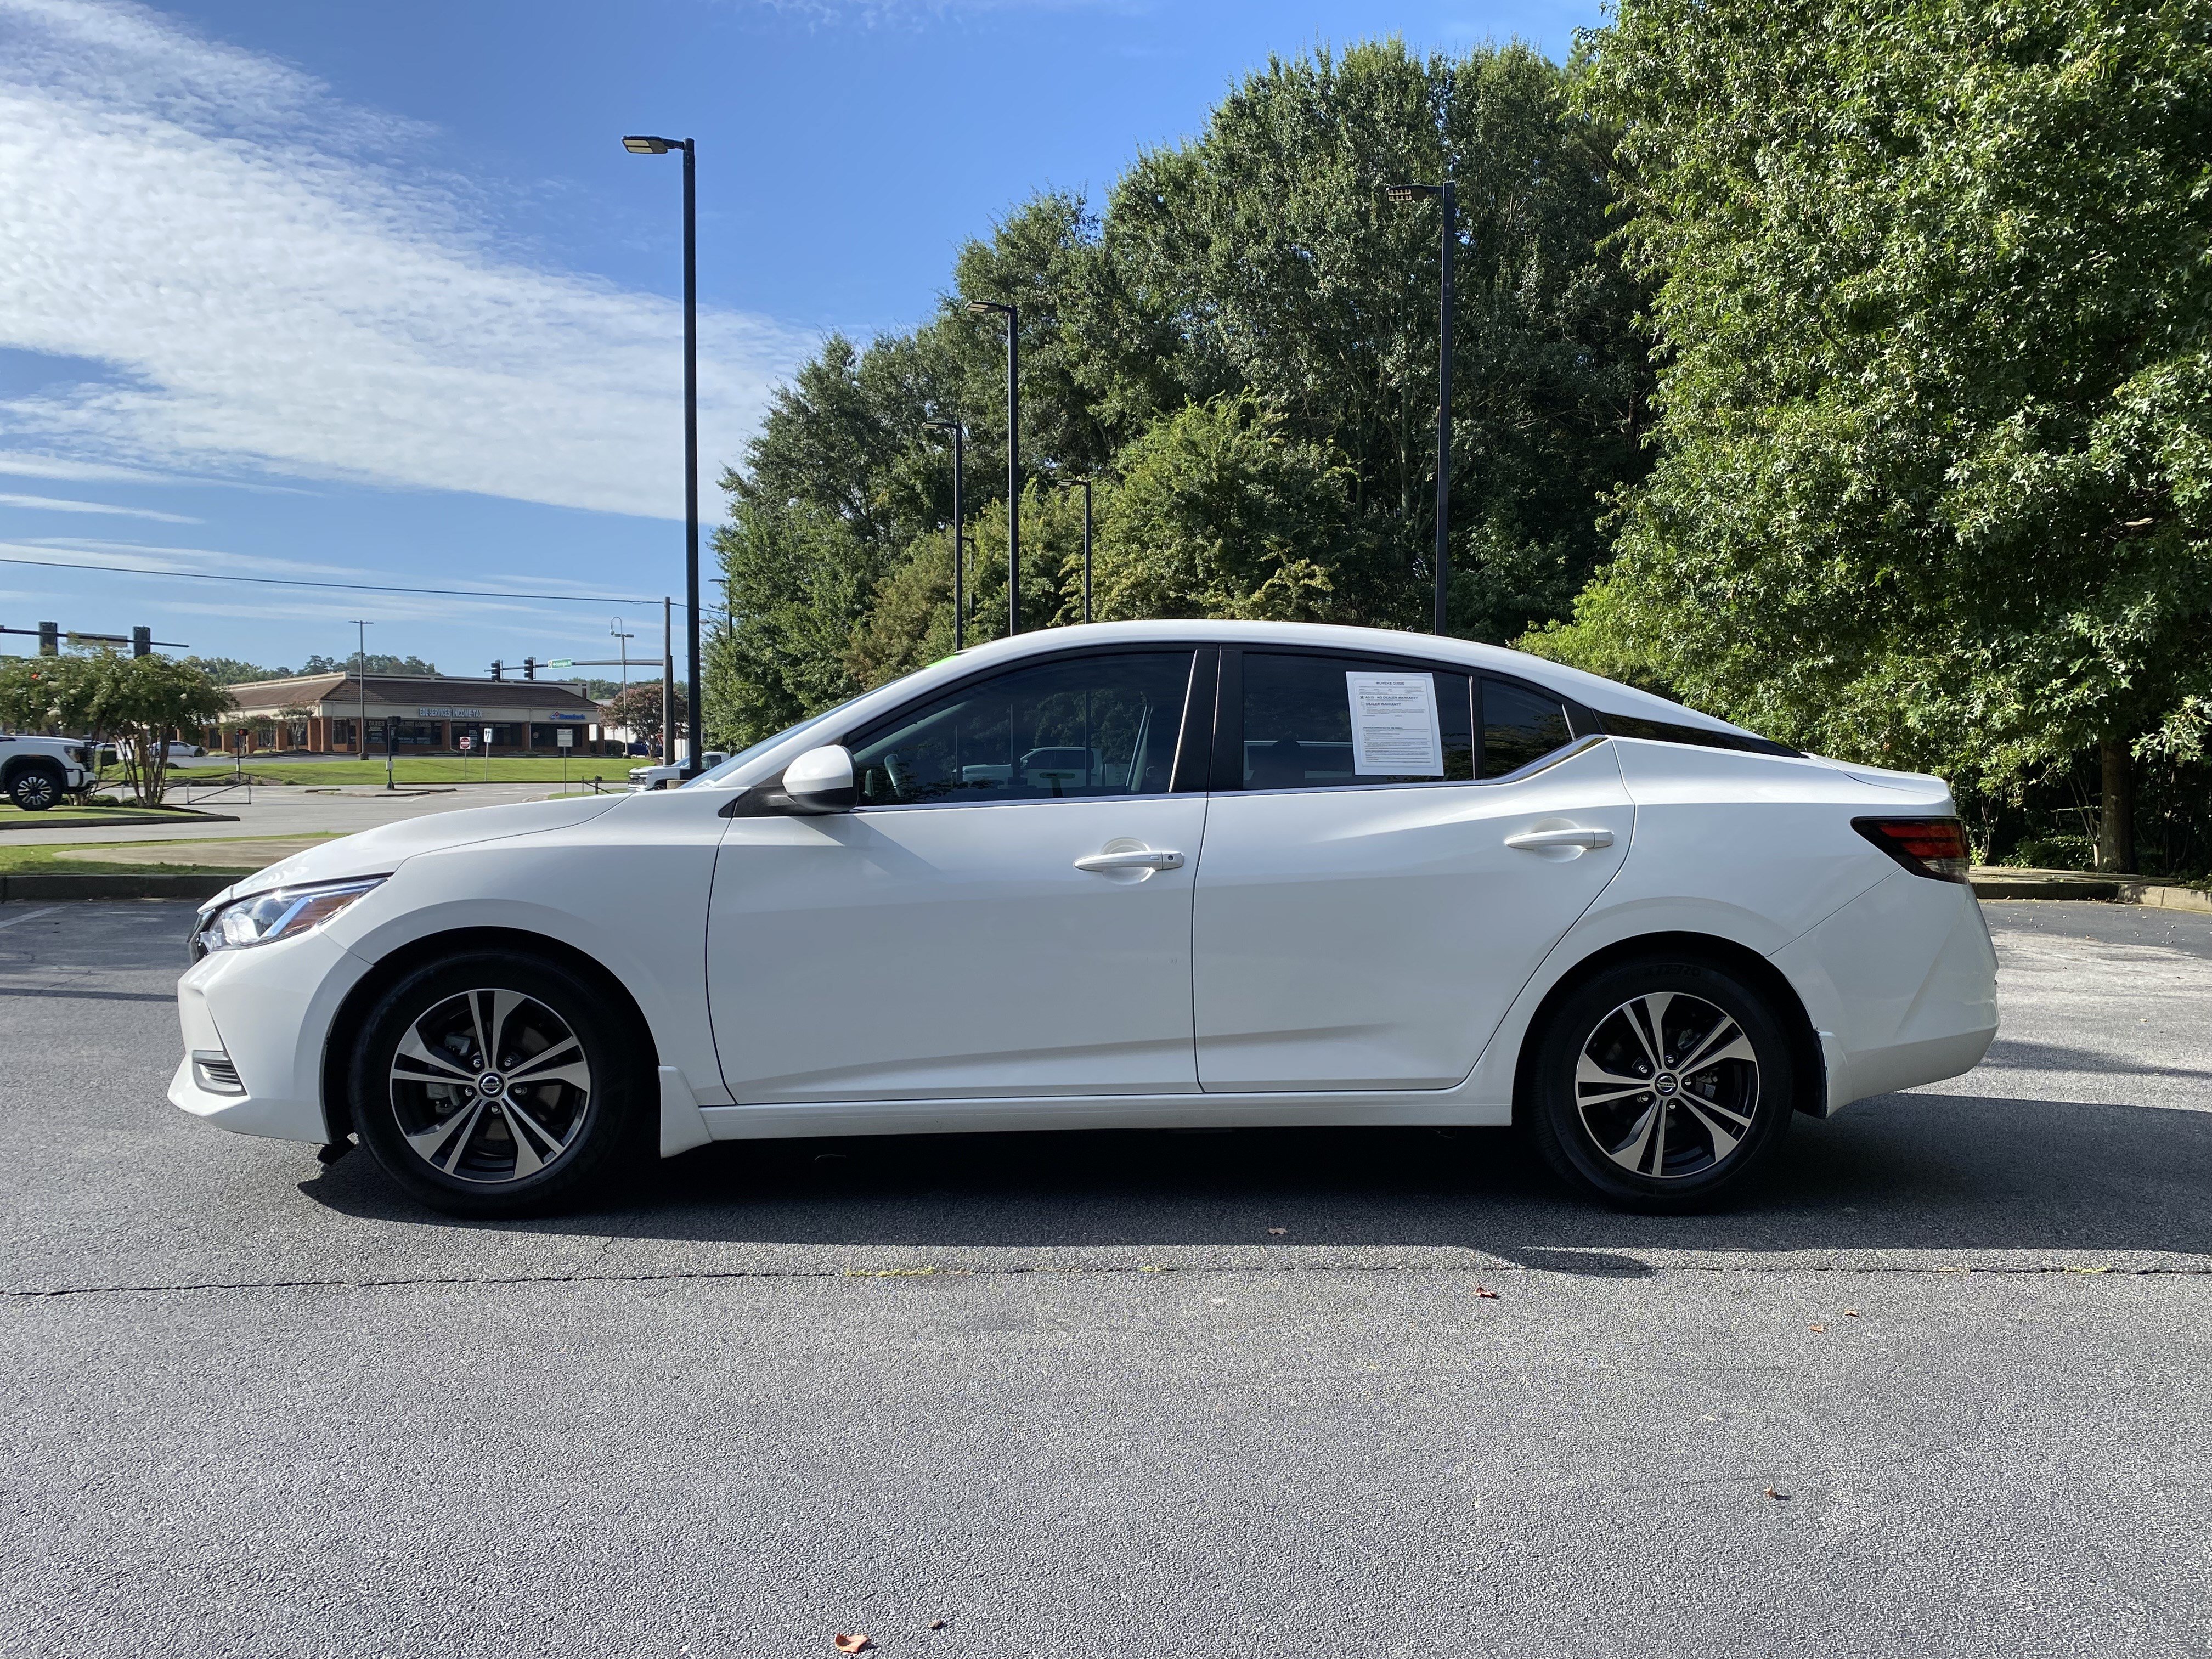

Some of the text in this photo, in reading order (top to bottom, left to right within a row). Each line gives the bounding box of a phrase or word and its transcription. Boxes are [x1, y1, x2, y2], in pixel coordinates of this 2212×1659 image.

[429, 708, 450, 717] SERVICES
[452, 709, 472, 718] INCOME
[472, 709, 483, 718] TAX
